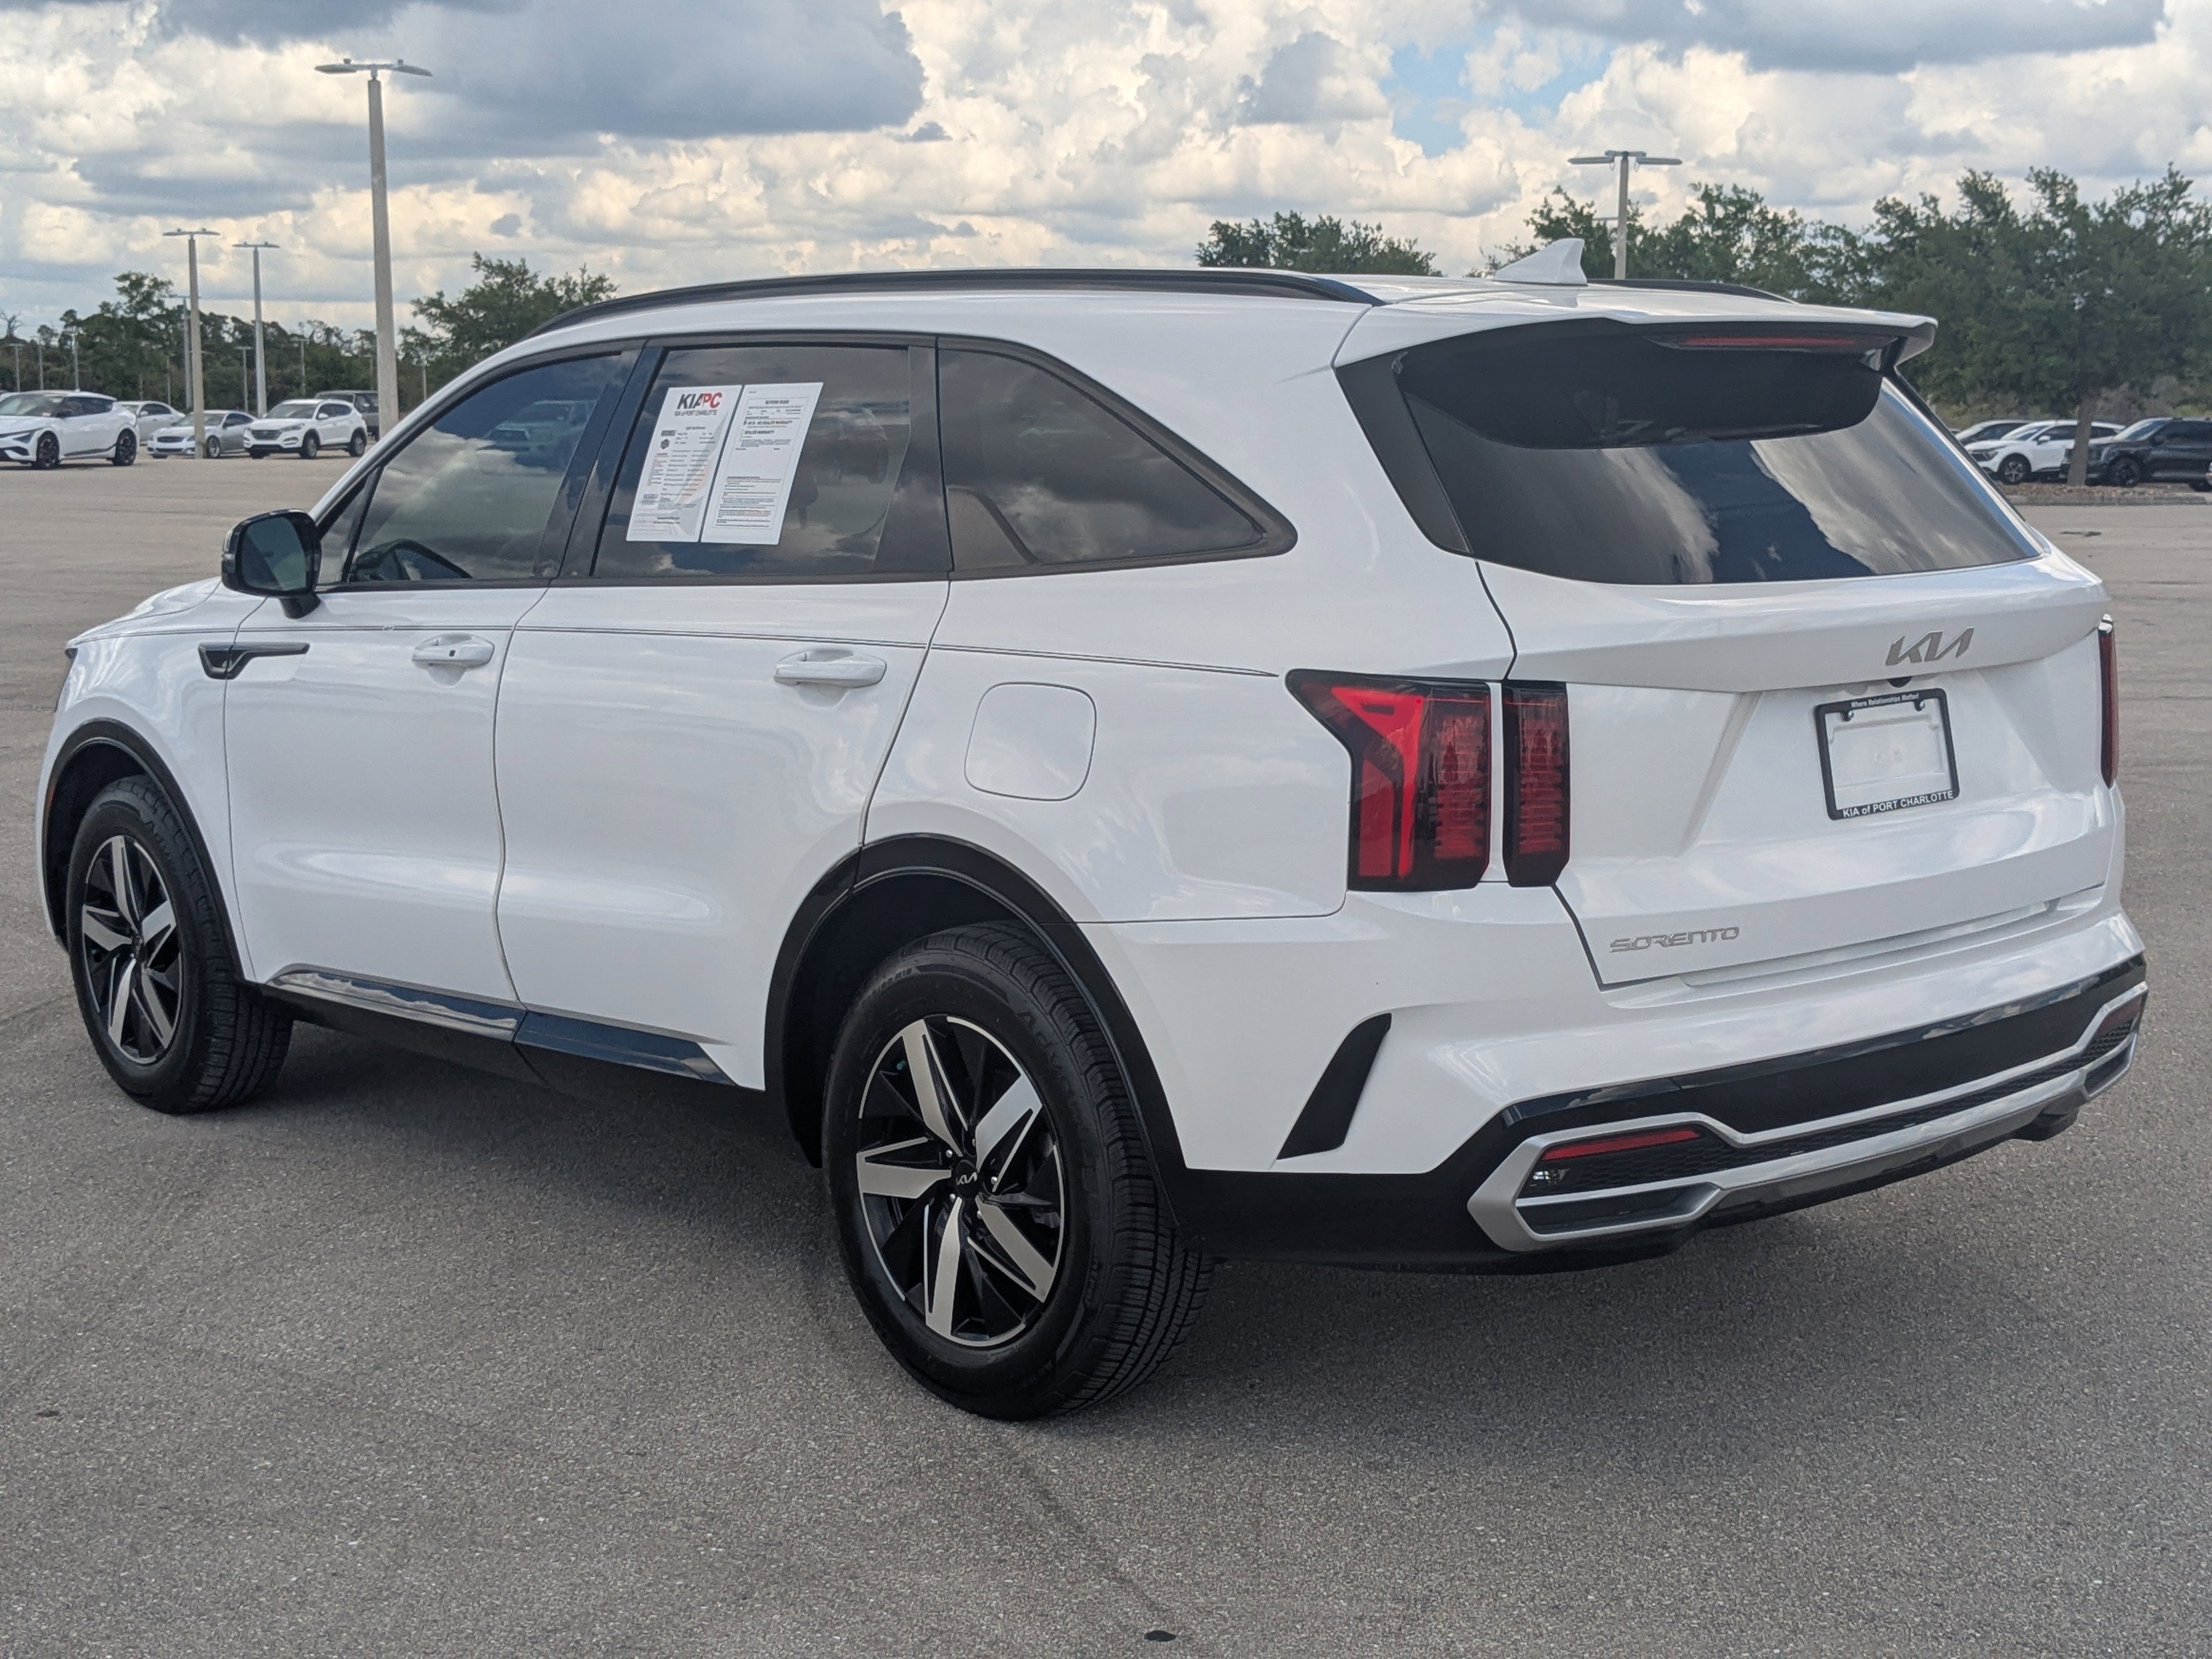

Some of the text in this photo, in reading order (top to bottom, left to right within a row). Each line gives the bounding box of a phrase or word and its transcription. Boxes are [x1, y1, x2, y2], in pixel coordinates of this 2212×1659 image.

[1885, 626, 1974, 666] KIA
[1843, 789, 1954, 818] KIA of PORT CHARLOTTE
[1609, 926, 1740, 953] SORENTO
